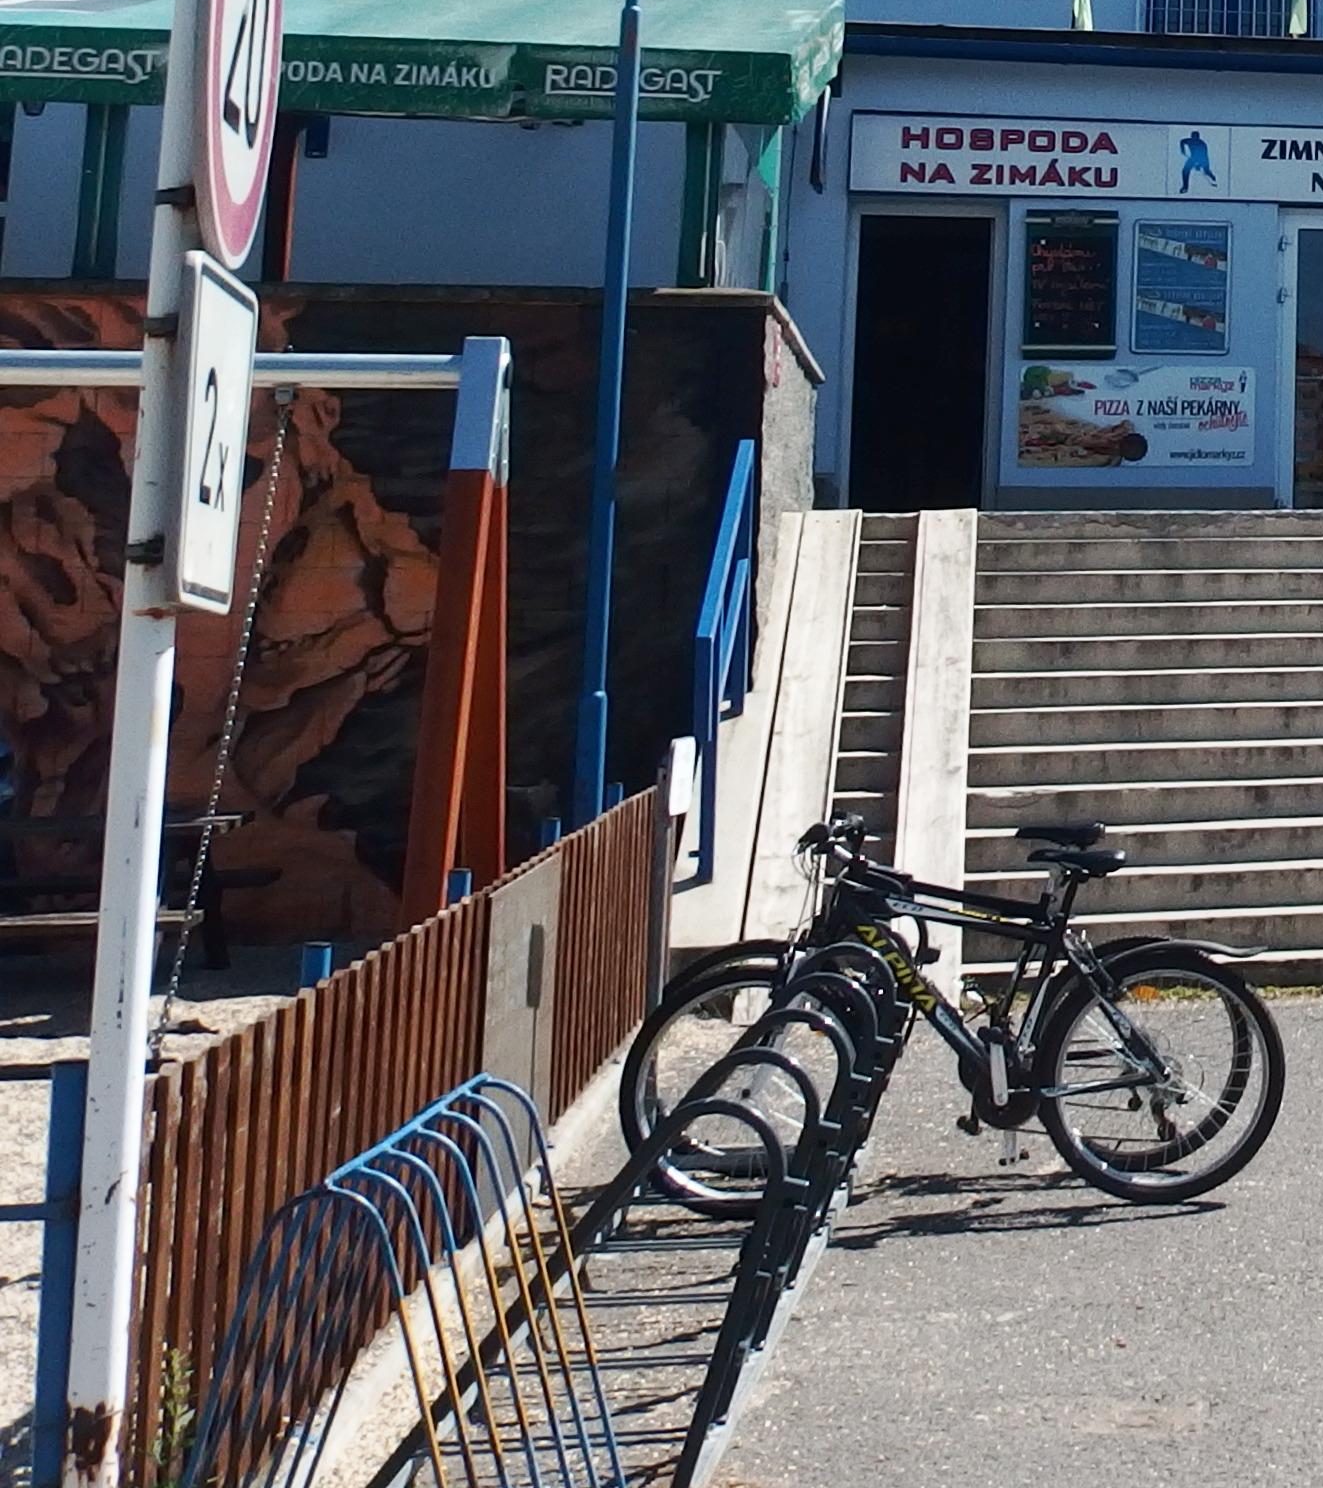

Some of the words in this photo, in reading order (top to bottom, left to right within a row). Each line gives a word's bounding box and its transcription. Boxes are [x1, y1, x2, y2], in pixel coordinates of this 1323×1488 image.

[0, 45, 161, 85] ADEGAST
[350, 62, 387, 86] NA
[393, 61, 497, 89] ZIMÁKU
[545, 64, 723, 103] RADGAST
[901, 126, 1118, 155] HOSPODA
[900, 162, 956, 184] NA
[969, 158, 1118, 188] ZIMÁKU
[1094, 399, 1130, 416] PIZZA
[1136, 399, 1144, 416] Z
[1147, 396, 1178, 416] NAŠÍ
[1181, 396, 1241, 416] PEKÁRNY
